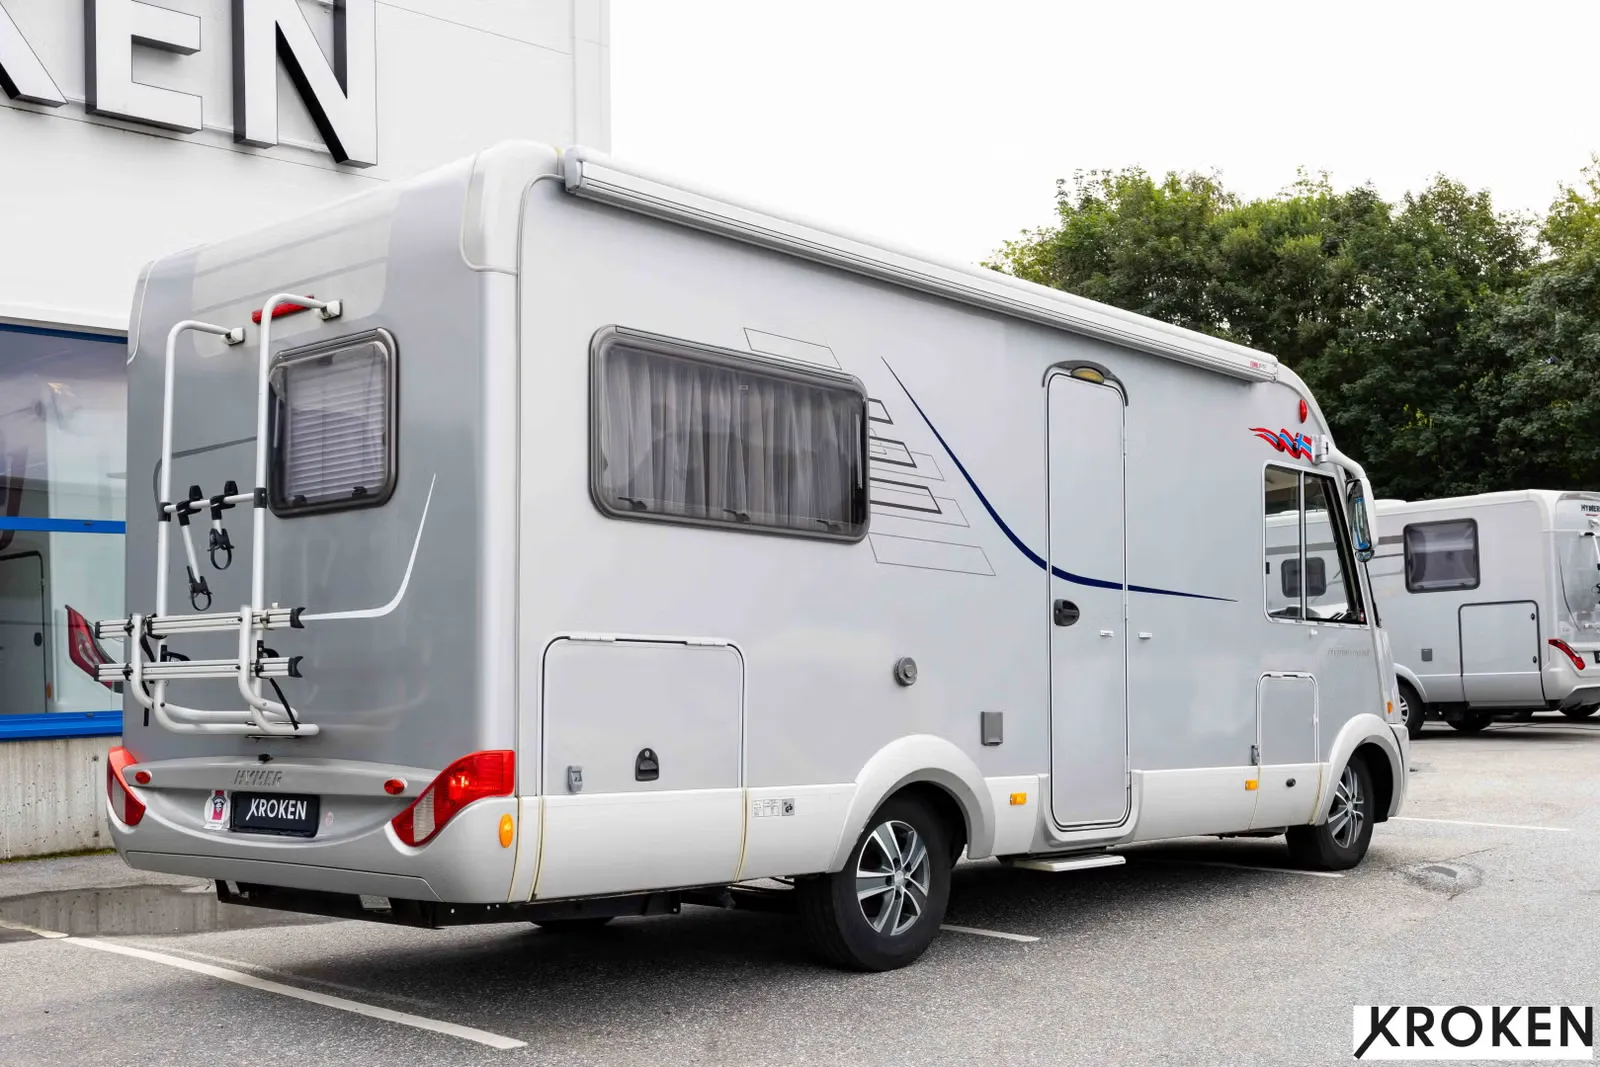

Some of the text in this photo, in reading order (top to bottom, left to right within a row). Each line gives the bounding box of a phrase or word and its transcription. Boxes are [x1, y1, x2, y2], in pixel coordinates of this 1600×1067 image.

[0, 0, 377, 167] EN
[233, 769, 284, 787] HYMER
[246, 798, 307, 821] KROKEN
